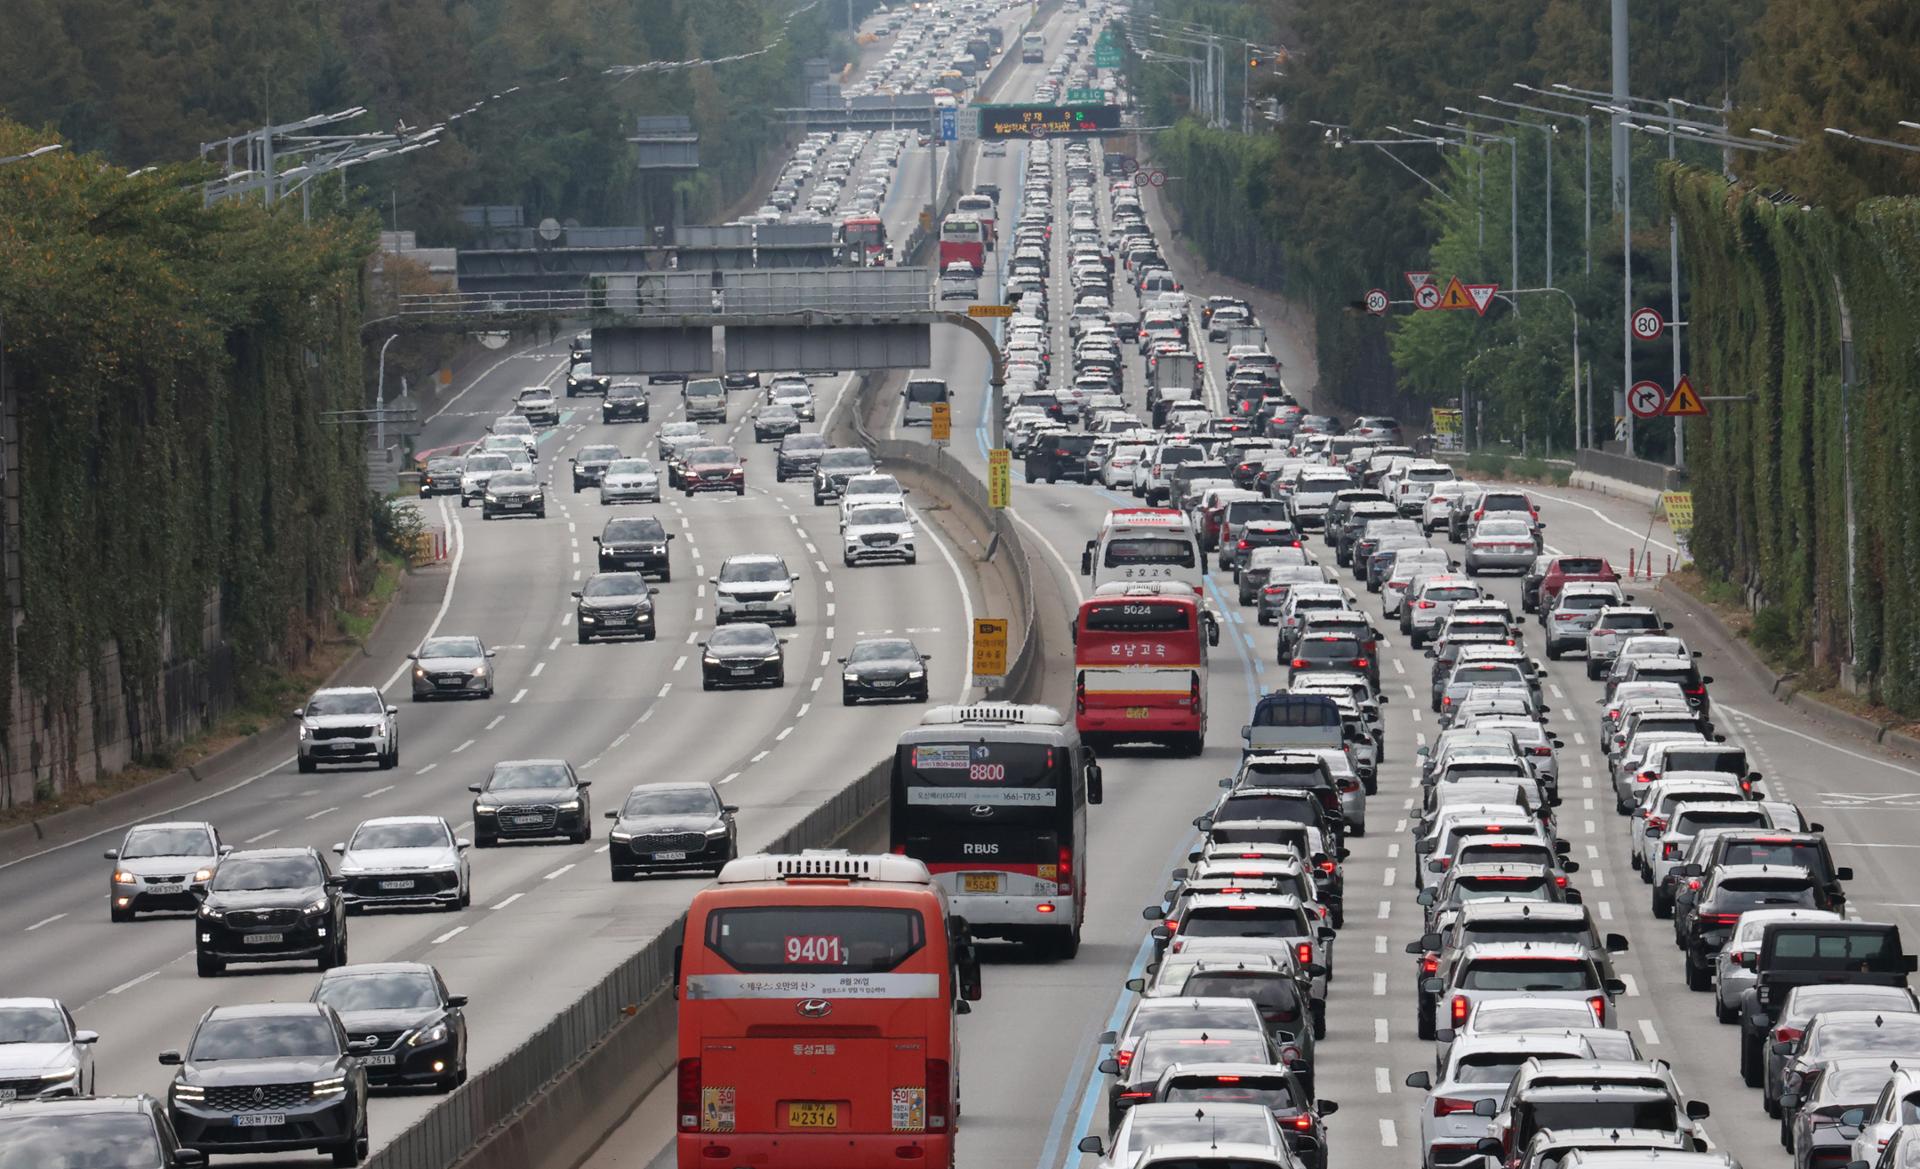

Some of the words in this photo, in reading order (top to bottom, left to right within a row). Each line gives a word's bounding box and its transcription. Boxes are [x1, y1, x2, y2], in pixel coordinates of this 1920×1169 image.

[1370, 296, 1385, 308] 80
[1638, 318, 1657, 332] 80
[1124, 605, 1151, 614] 5024
[1111, 643, 1166, 657] 호남고속
[970, 764, 1004, 780] 8800
[787, 937, 840, 962] 9401
[718, 1091, 733, 1104] 주의
[892, 1090, 909, 1104] 주의
